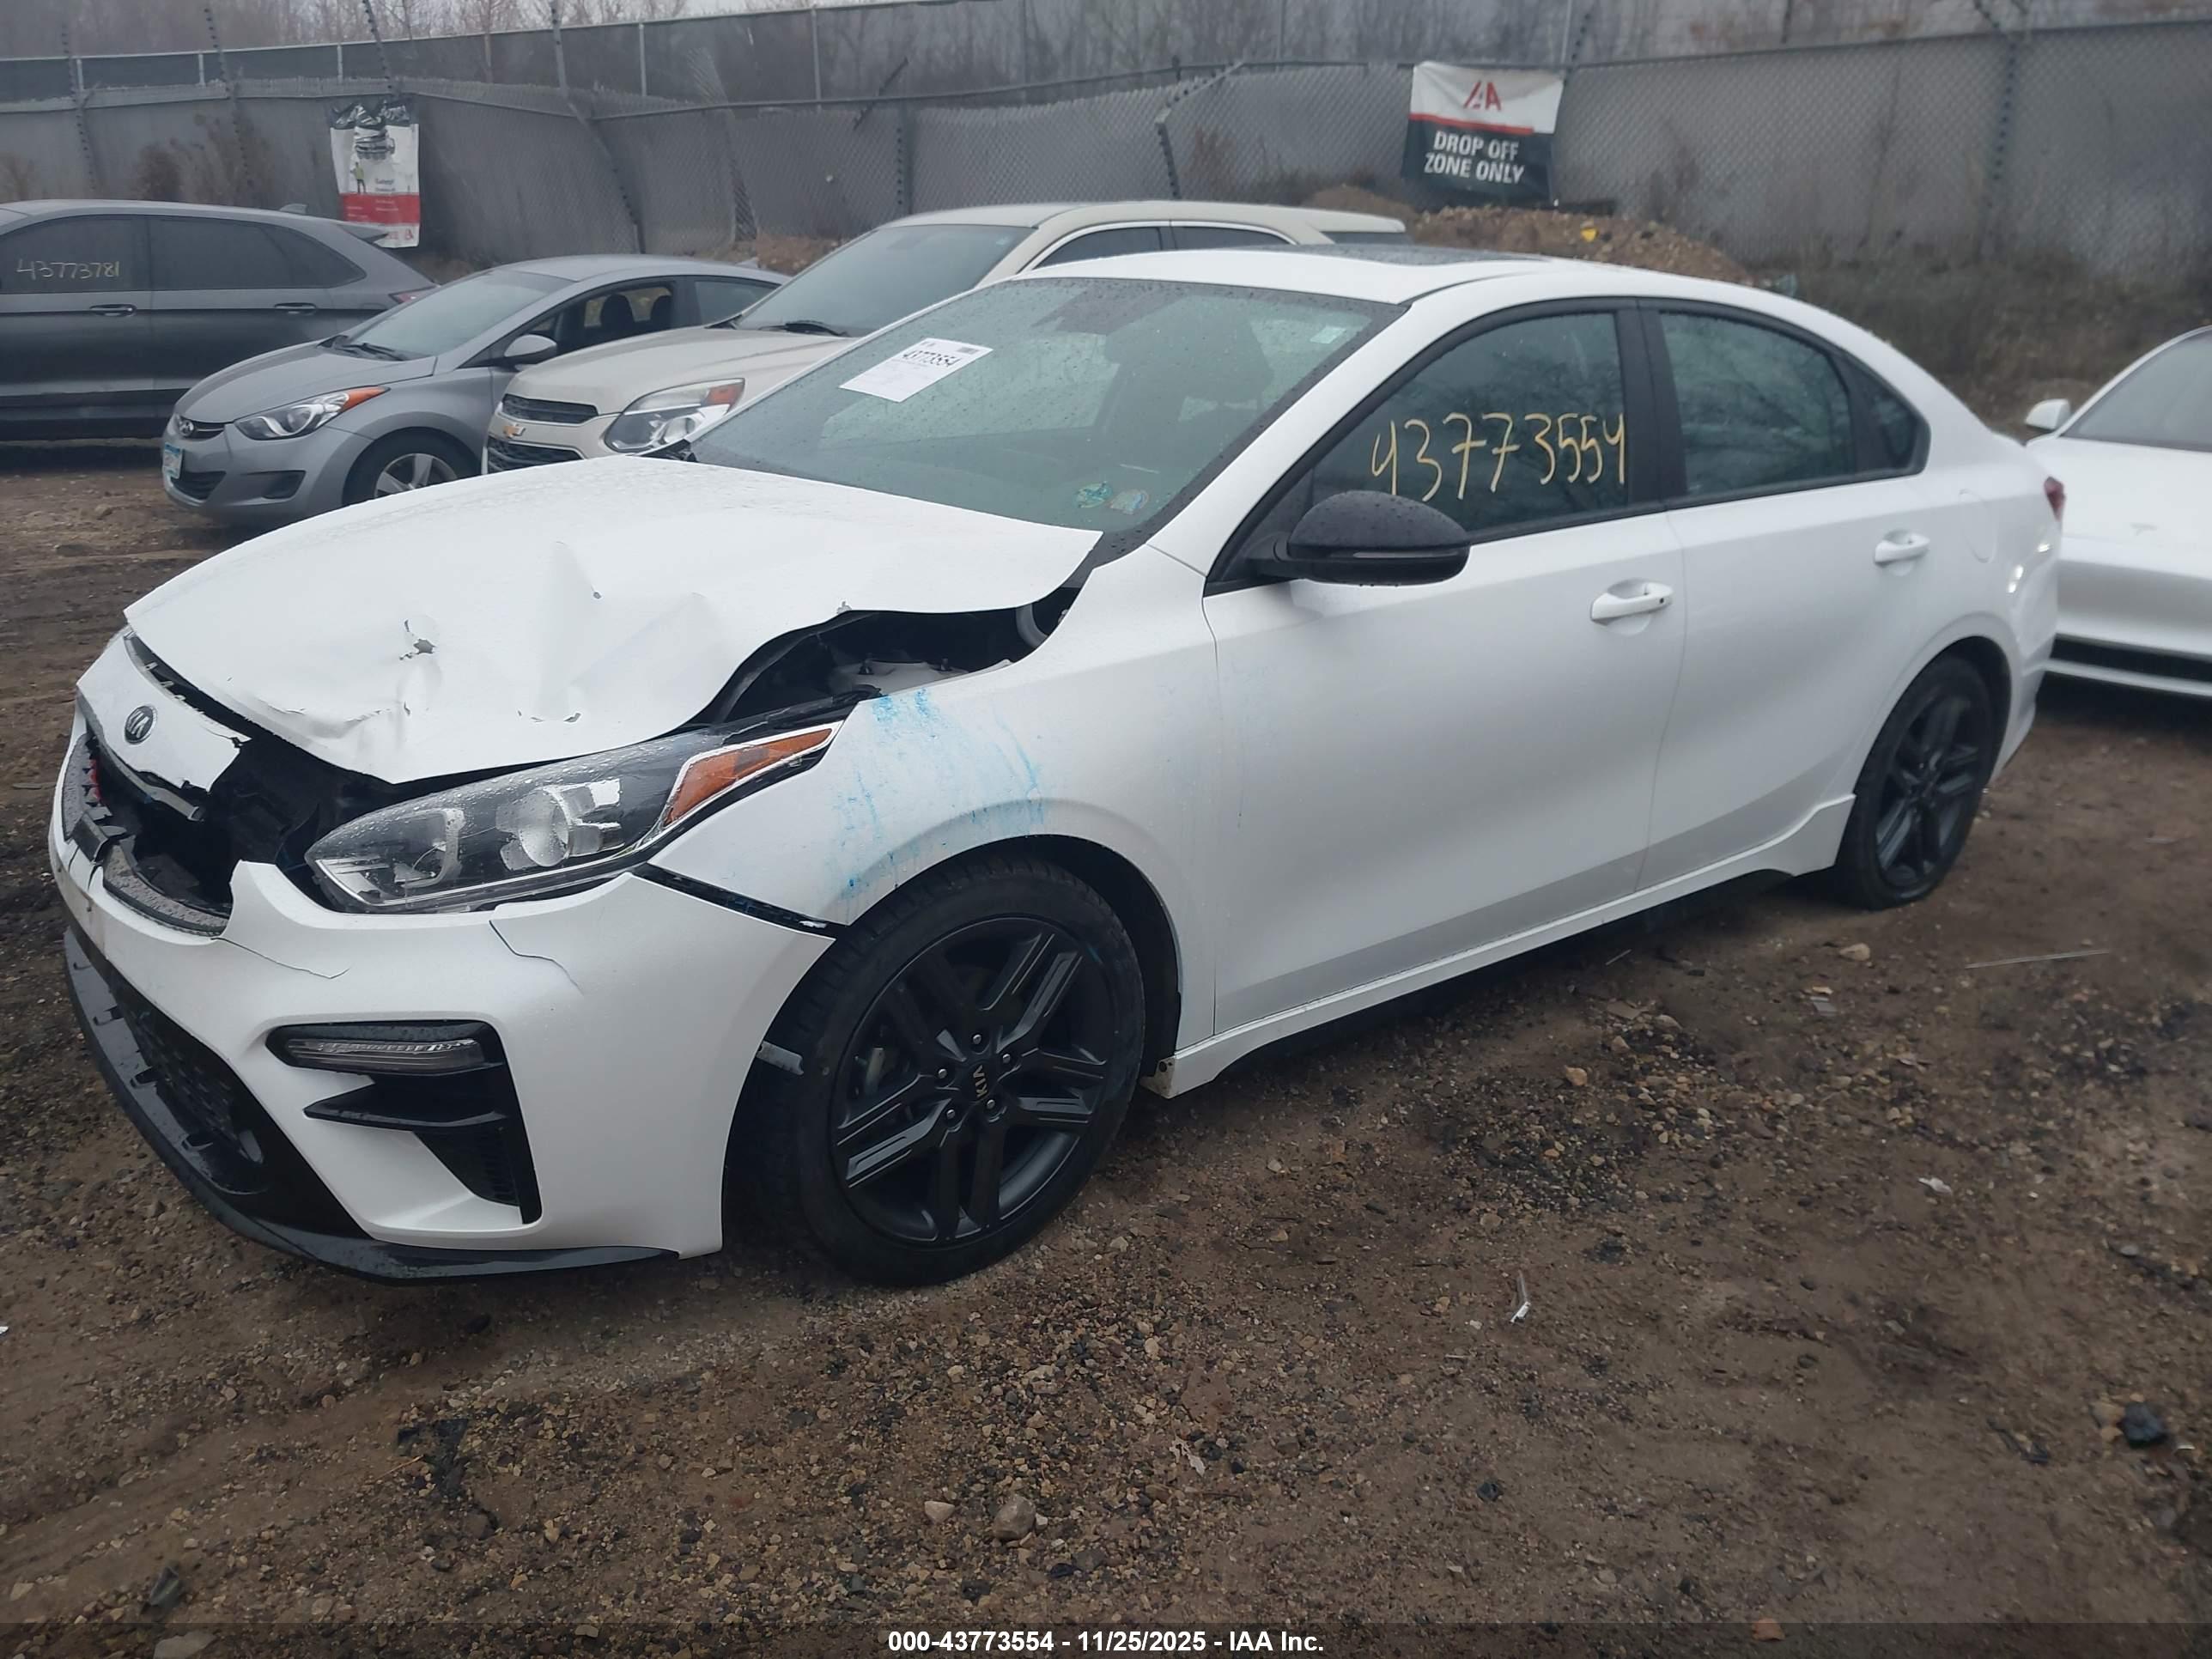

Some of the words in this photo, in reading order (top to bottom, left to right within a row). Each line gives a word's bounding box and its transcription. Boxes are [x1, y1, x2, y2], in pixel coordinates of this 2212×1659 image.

[1434, 130, 1484, 156] DROP
[1487, 139, 1519, 161] OFF
[1424, 152, 1472, 178] ZONE
[1475, 160, 1524, 184] ONLY
[16, 258, 120, 280] 43773781
[1372, 412, 1626, 501] 43773554
[973, 1065, 988, 1098] KIA
